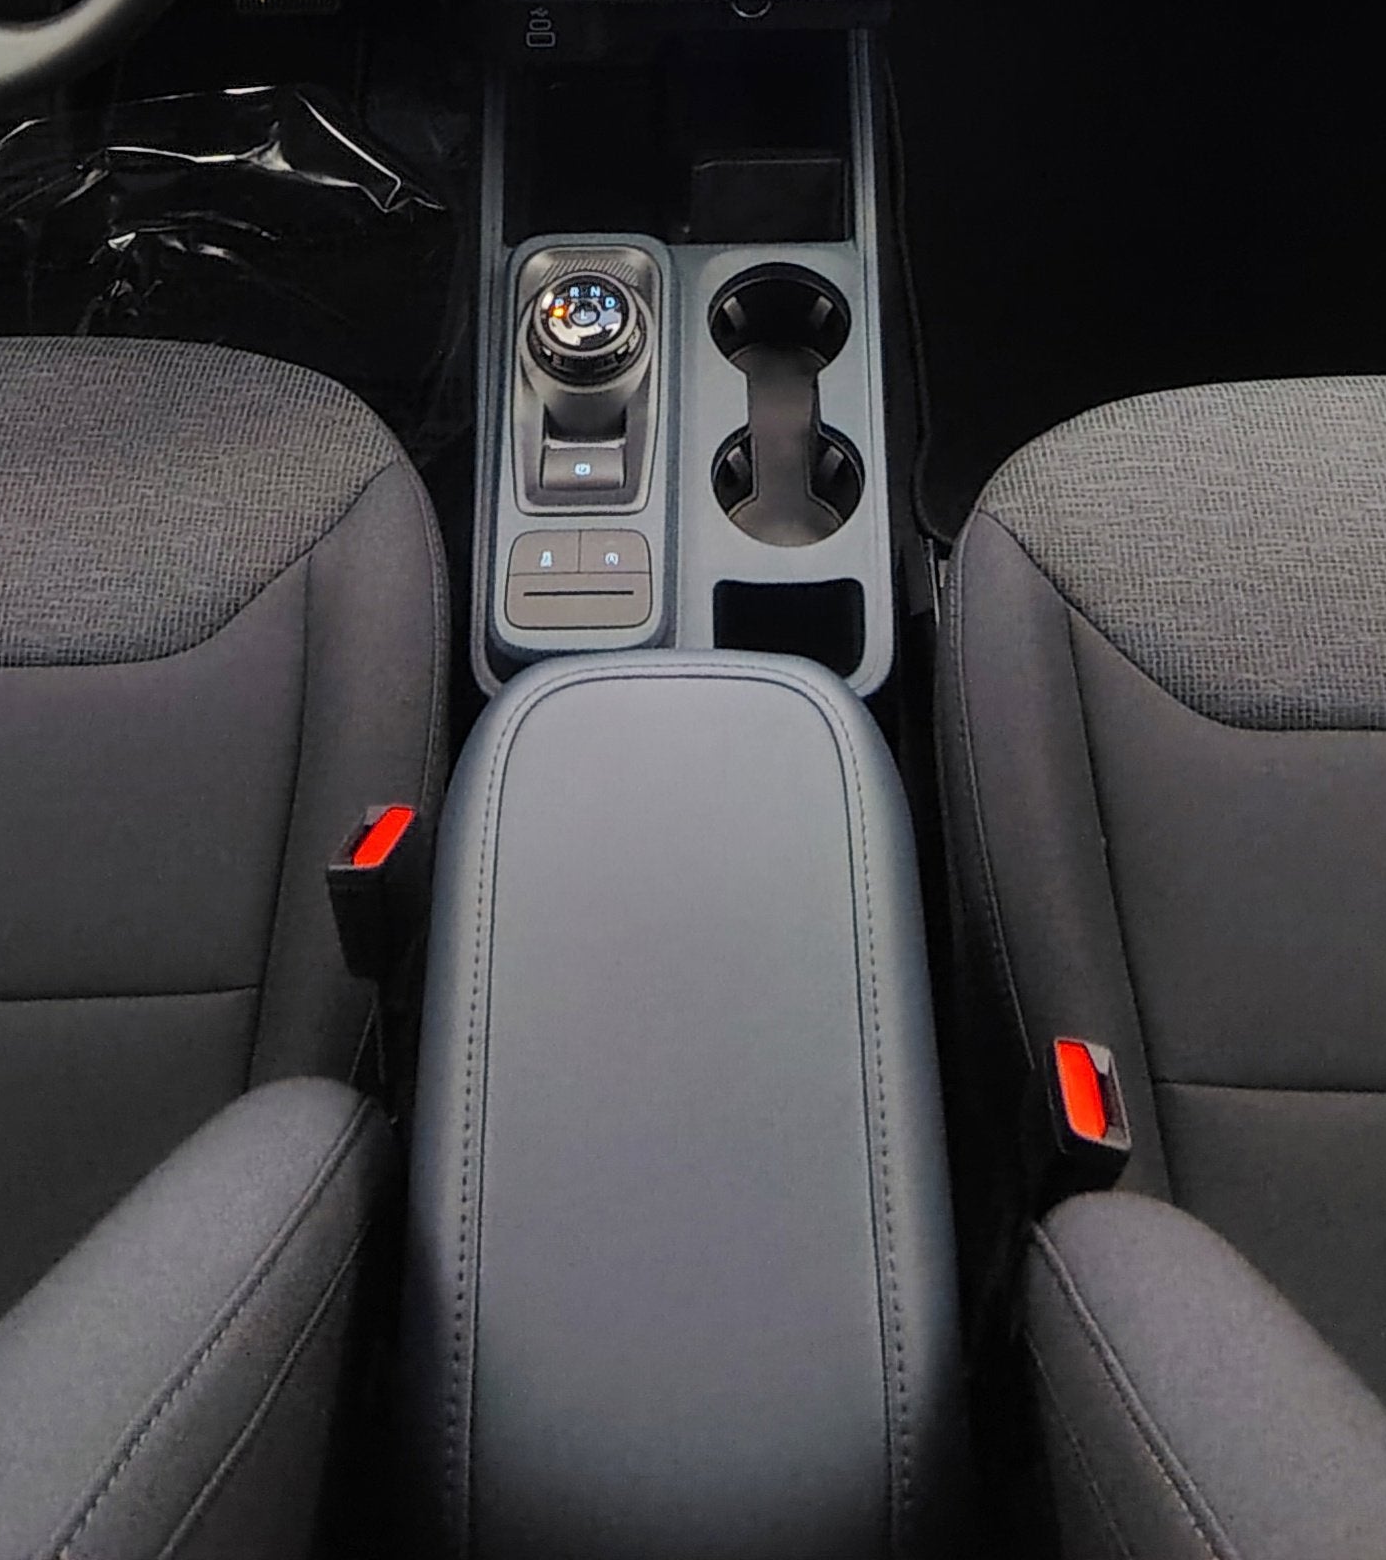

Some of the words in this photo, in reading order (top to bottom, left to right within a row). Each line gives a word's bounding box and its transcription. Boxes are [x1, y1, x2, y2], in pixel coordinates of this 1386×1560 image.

[569, 286, 580, 297] R
[590, 285, 601, 297] N
[605, 297, 616, 308] D
